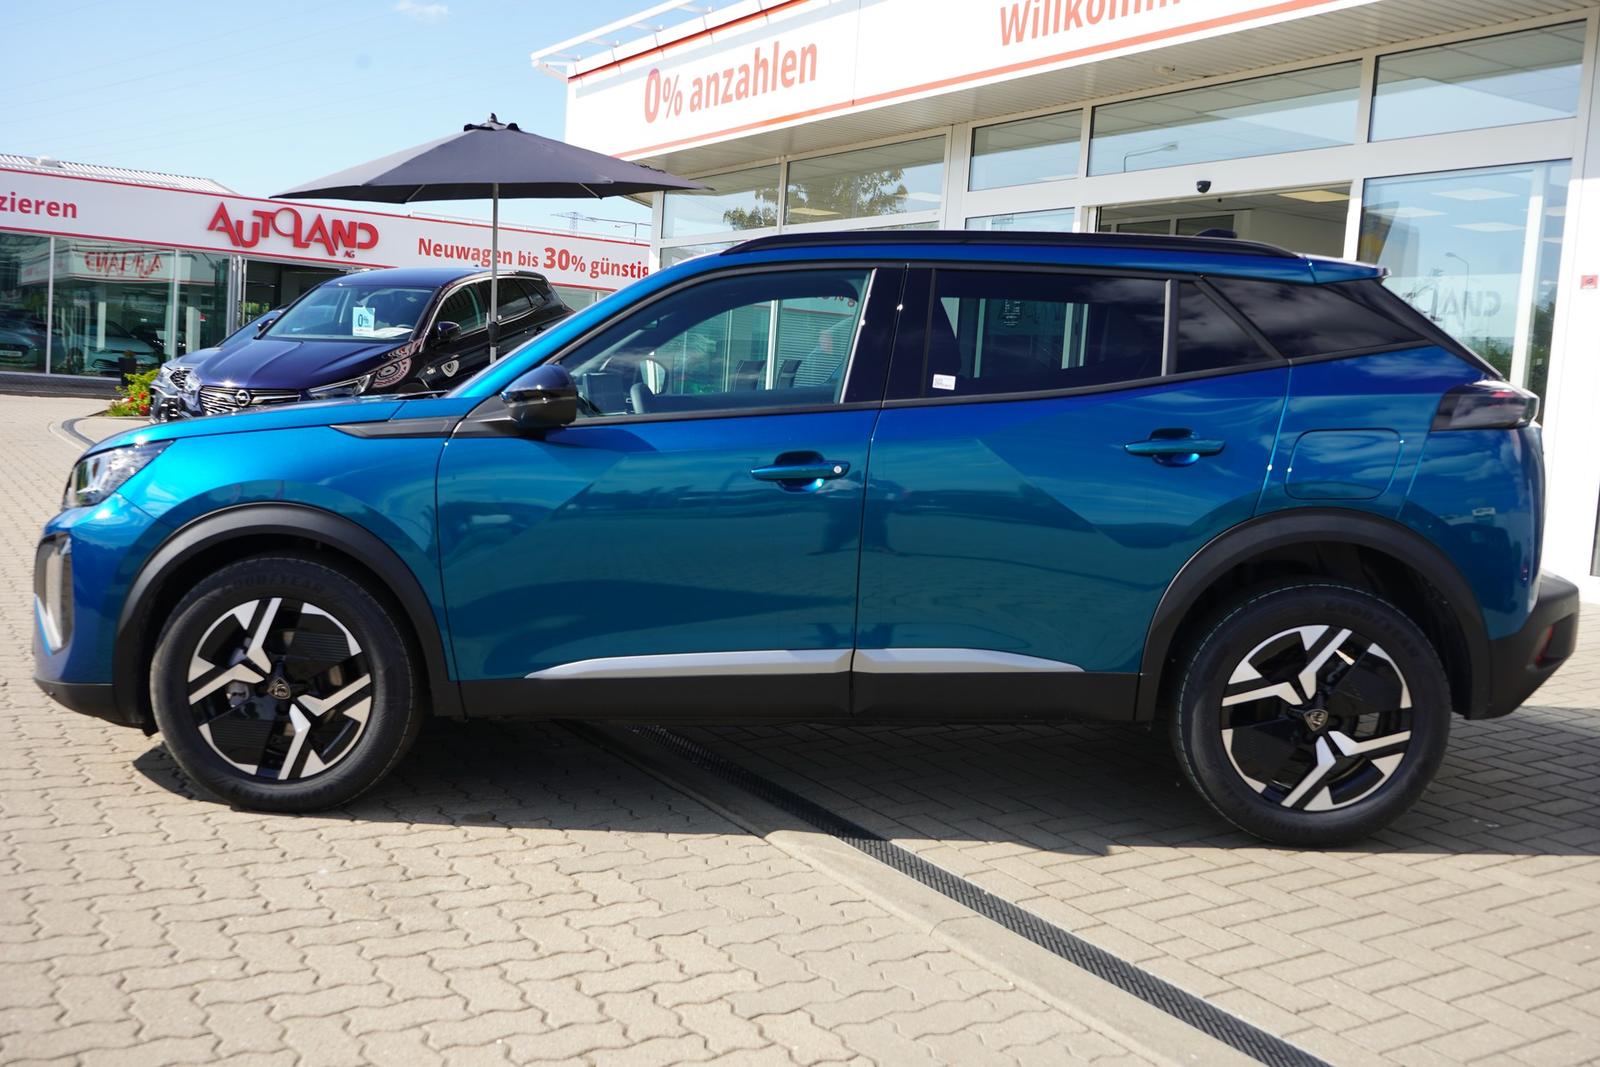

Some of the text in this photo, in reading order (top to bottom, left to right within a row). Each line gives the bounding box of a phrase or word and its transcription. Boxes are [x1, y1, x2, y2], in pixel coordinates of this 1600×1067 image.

[644, 40, 818, 124] 0% anzahlen
[0, 191, 77, 219] zieren
[207, 201, 379, 256] AUTOLAND
[418, 238, 513, 267] Neuwagen
[517, 250, 539, 267] bis
[543, 247, 586, 273] 30%
